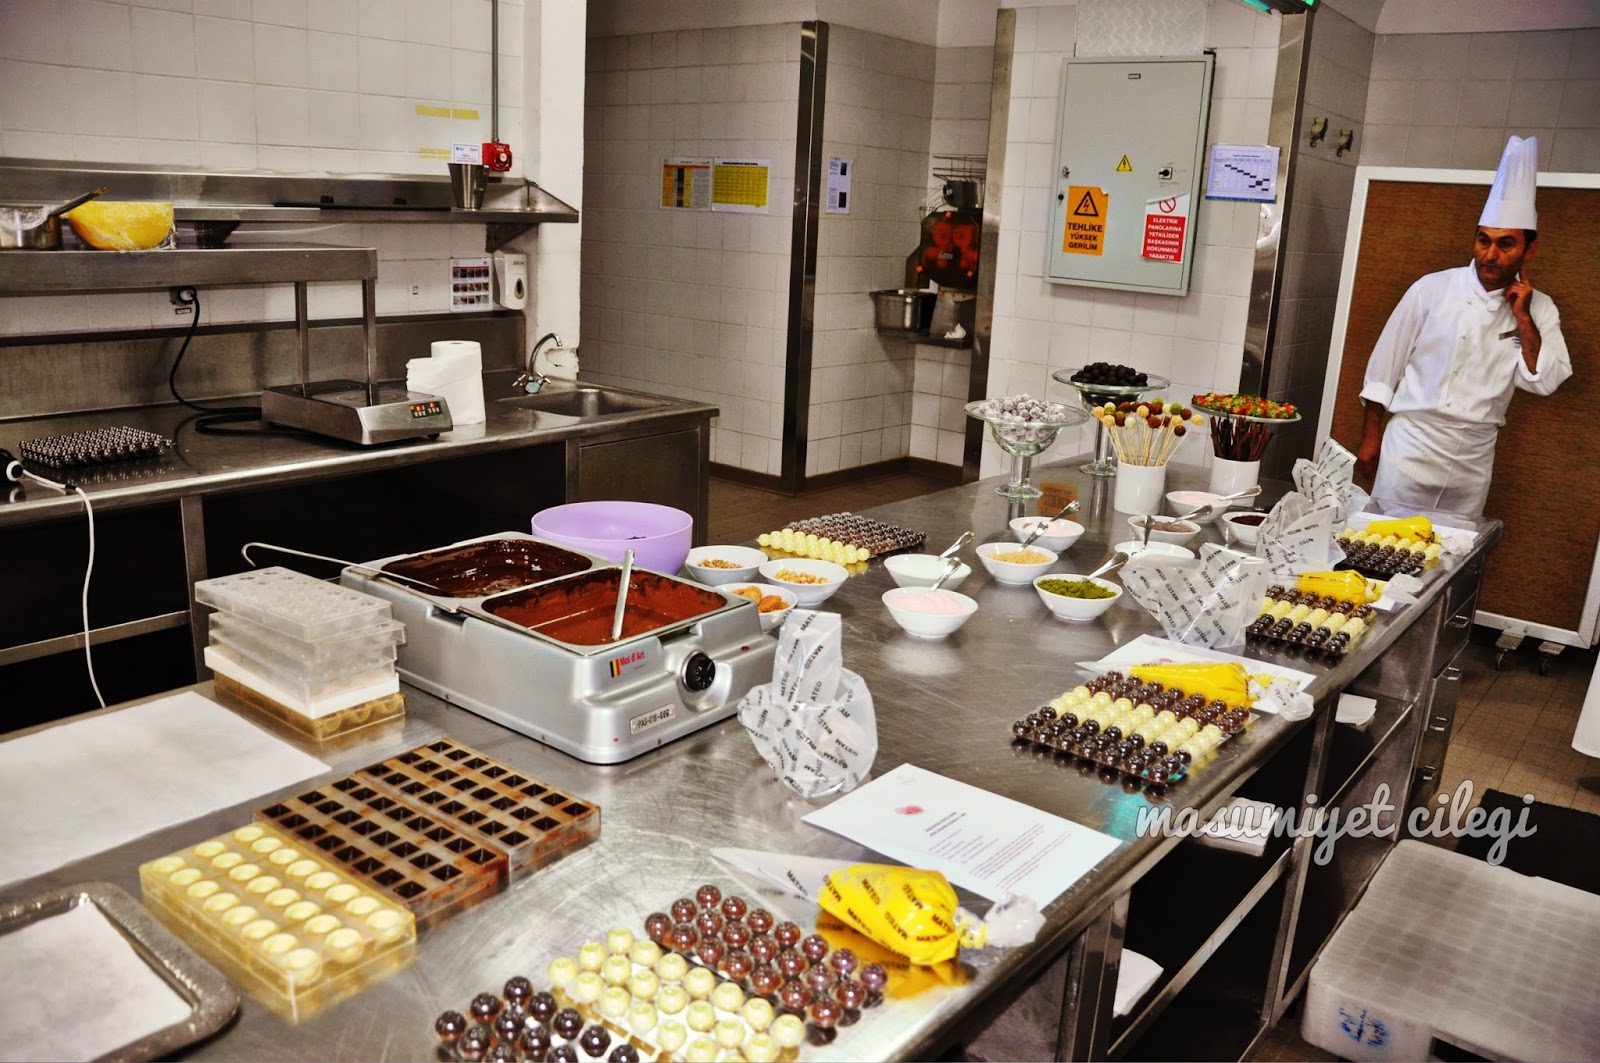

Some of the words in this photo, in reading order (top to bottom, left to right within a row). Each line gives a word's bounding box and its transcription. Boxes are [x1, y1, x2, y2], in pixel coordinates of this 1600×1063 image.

[1068, 222, 1103, 233] TEHLİKE
[1070, 232, 1098, 241] YÜKSEK
[1068, 241, 1098, 250] GERİLİM
[1165, 584, 1180, 601] MATEO
[1164, 611, 1176, 628] MATEO
[1213, 620, 1226, 636] MATEO
[1194, 626, 1209, 644] MATEO
[804, 644, 824, 670] MATEO
[781, 671, 790, 696] MATEO
[862, 878, 880, 906] MATEO
[903, 884, 923, 910] MATEO
[885, 912, 909, 940] MATEO
